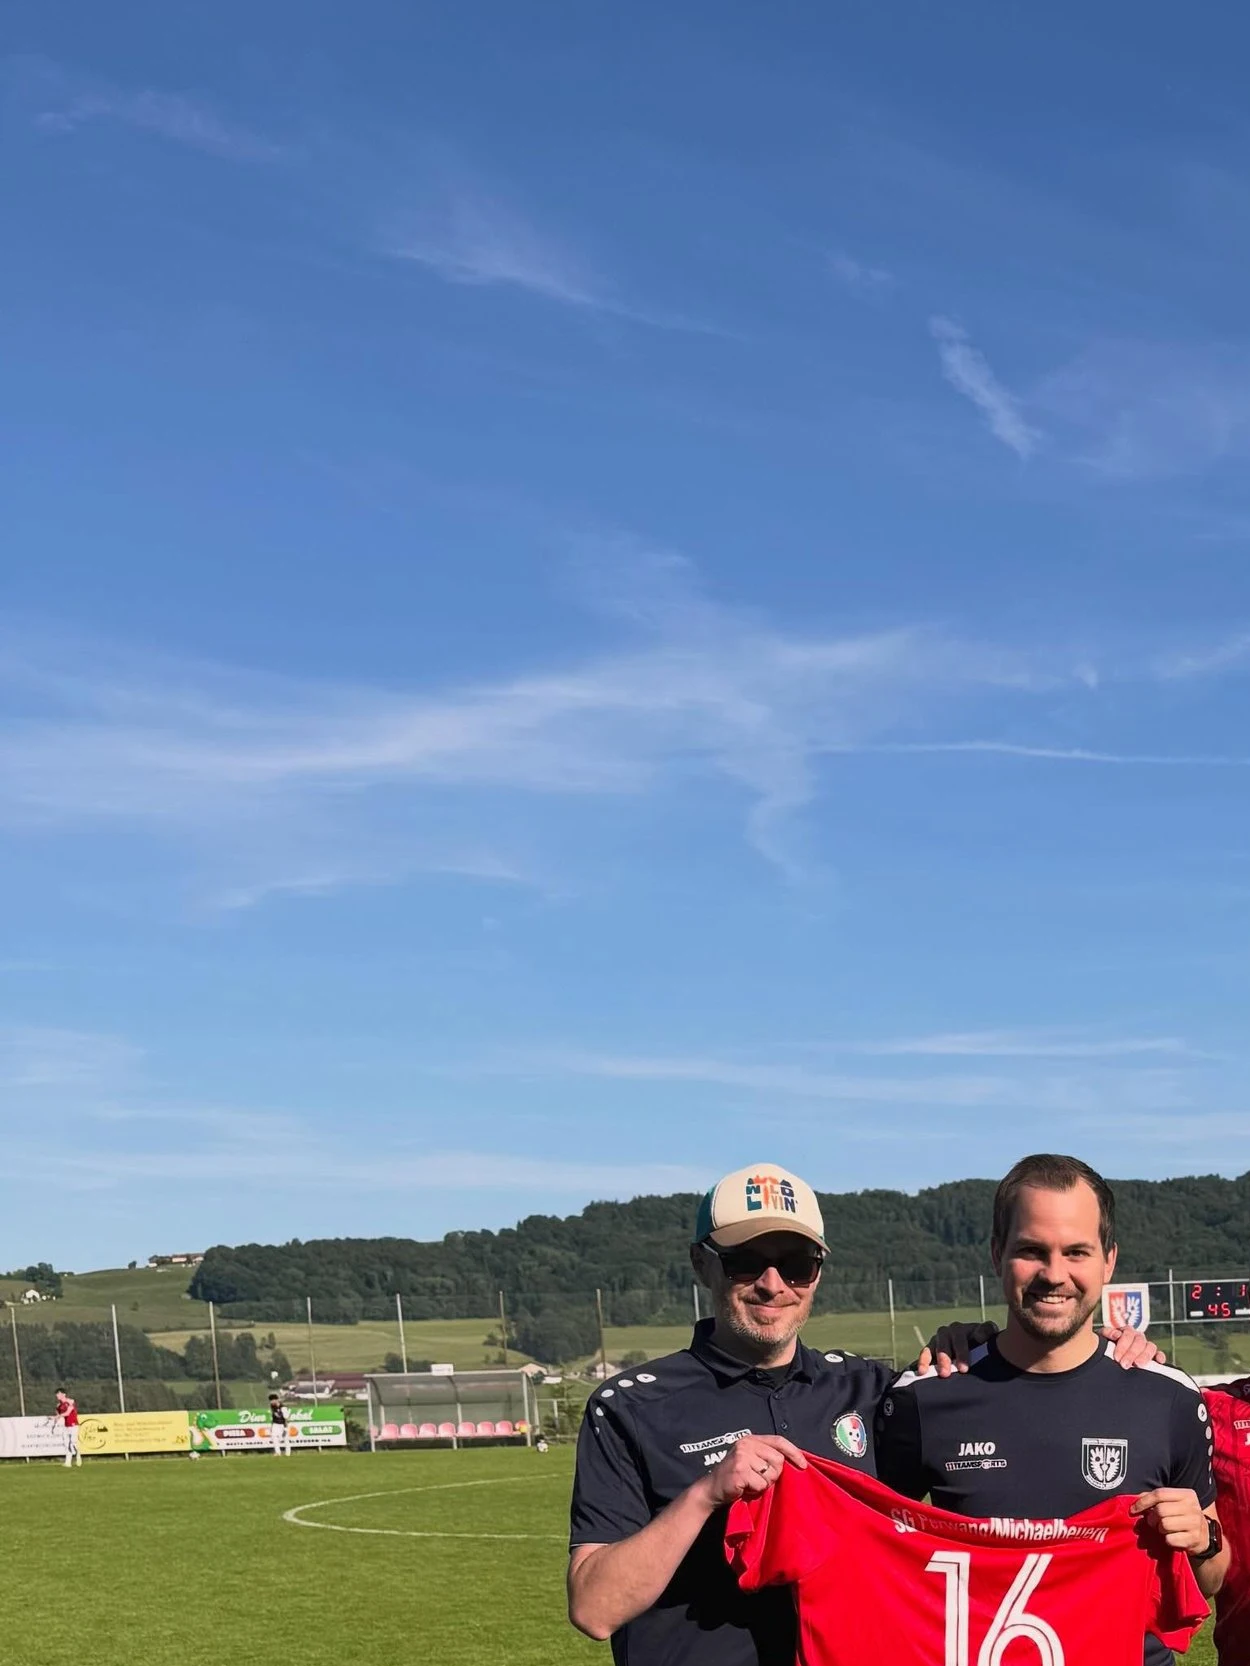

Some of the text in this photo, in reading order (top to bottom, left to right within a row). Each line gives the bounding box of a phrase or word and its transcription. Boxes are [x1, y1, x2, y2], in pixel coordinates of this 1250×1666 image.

[1191, 1284, 1203, 1300] 2
[1208, 1302, 1231, 1317] 45
[958, 1442, 996, 1456] JAKO
[704, 1450, 727, 1466] JAK
[891, 1508, 917, 1533] SG
